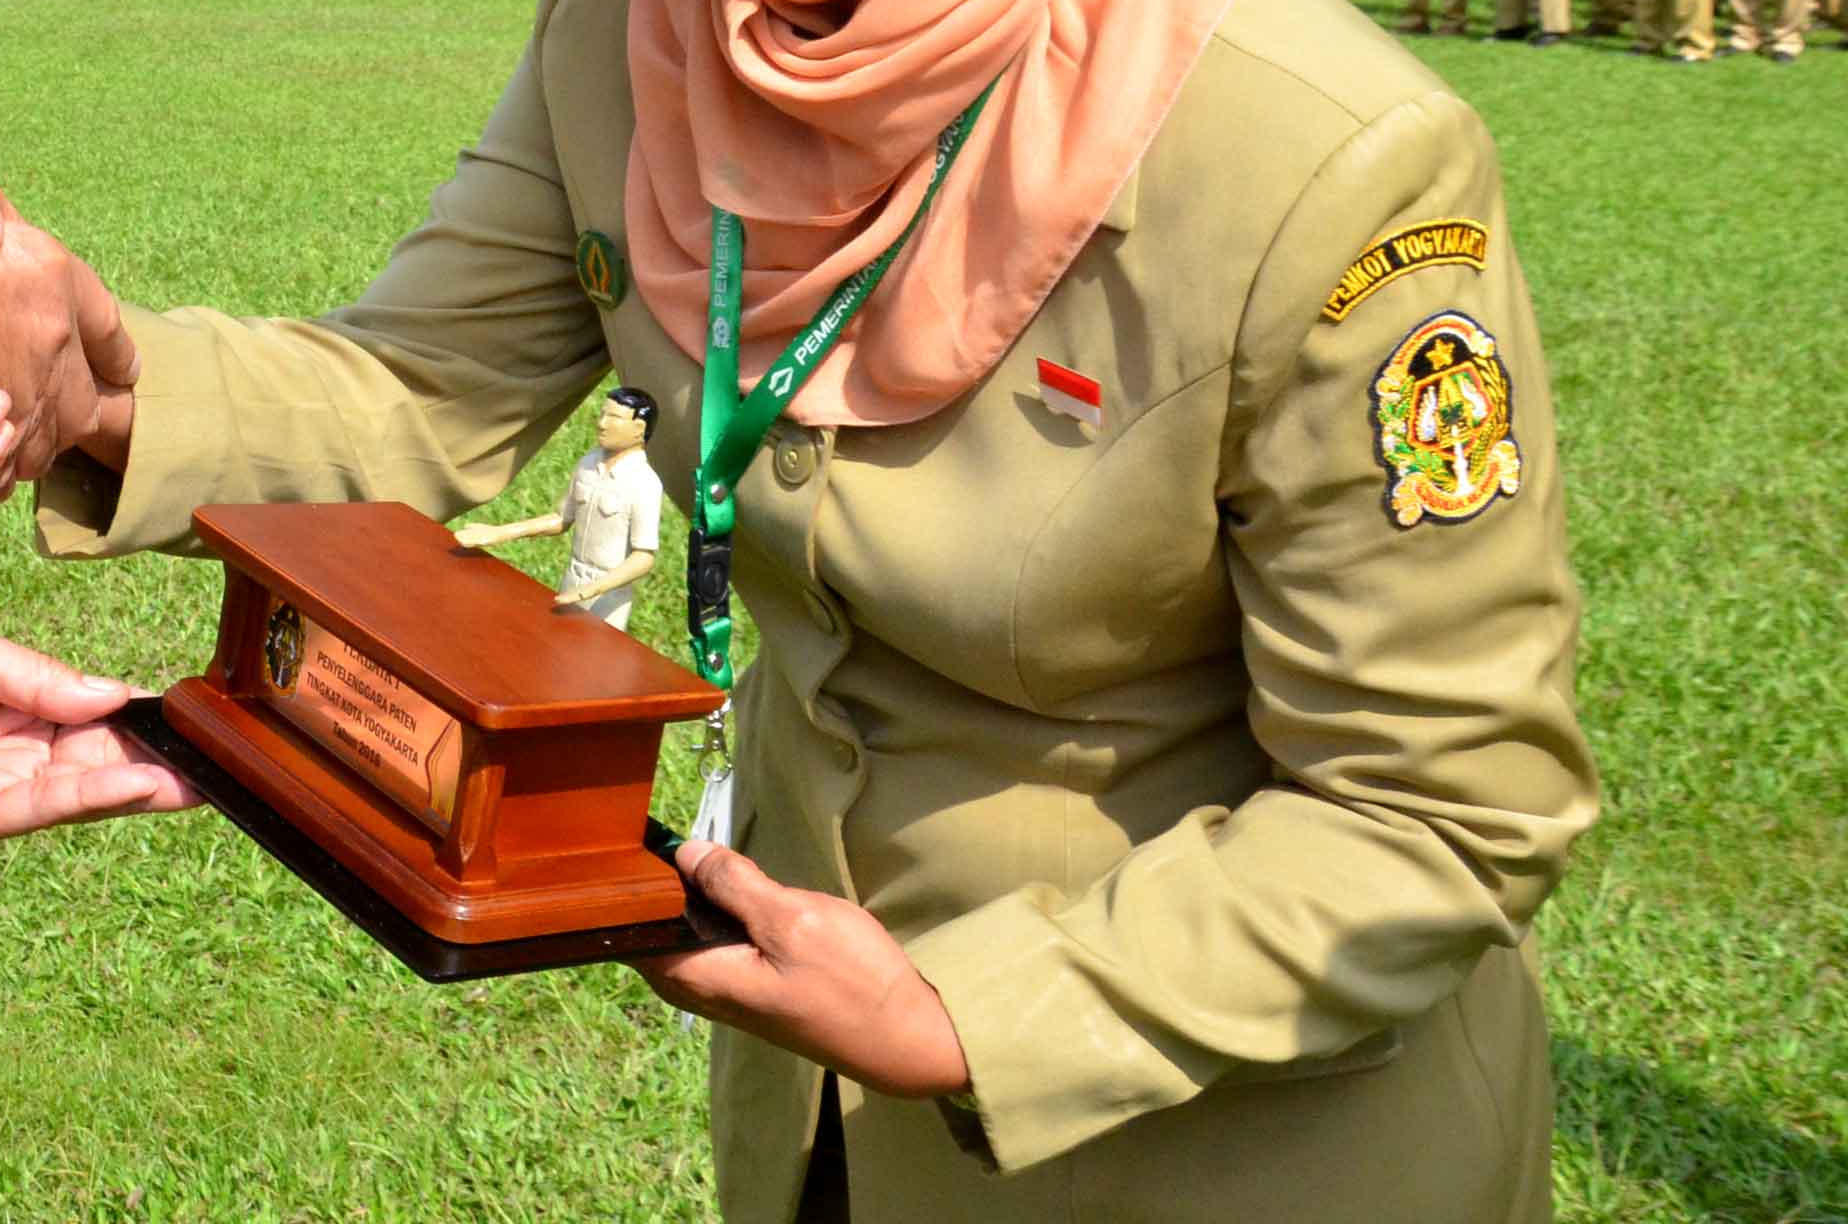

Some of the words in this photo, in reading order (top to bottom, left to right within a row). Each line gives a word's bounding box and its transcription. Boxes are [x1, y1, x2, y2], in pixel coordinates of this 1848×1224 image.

[306, 672, 341, 708] TINGKAT
[342, 696, 362, 724] KOTA
[364, 713, 419, 767] YOGYAKARTA
[317, 650, 388, 714] PENYELENGGARA
[389, 703, 417, 734] PATEN
